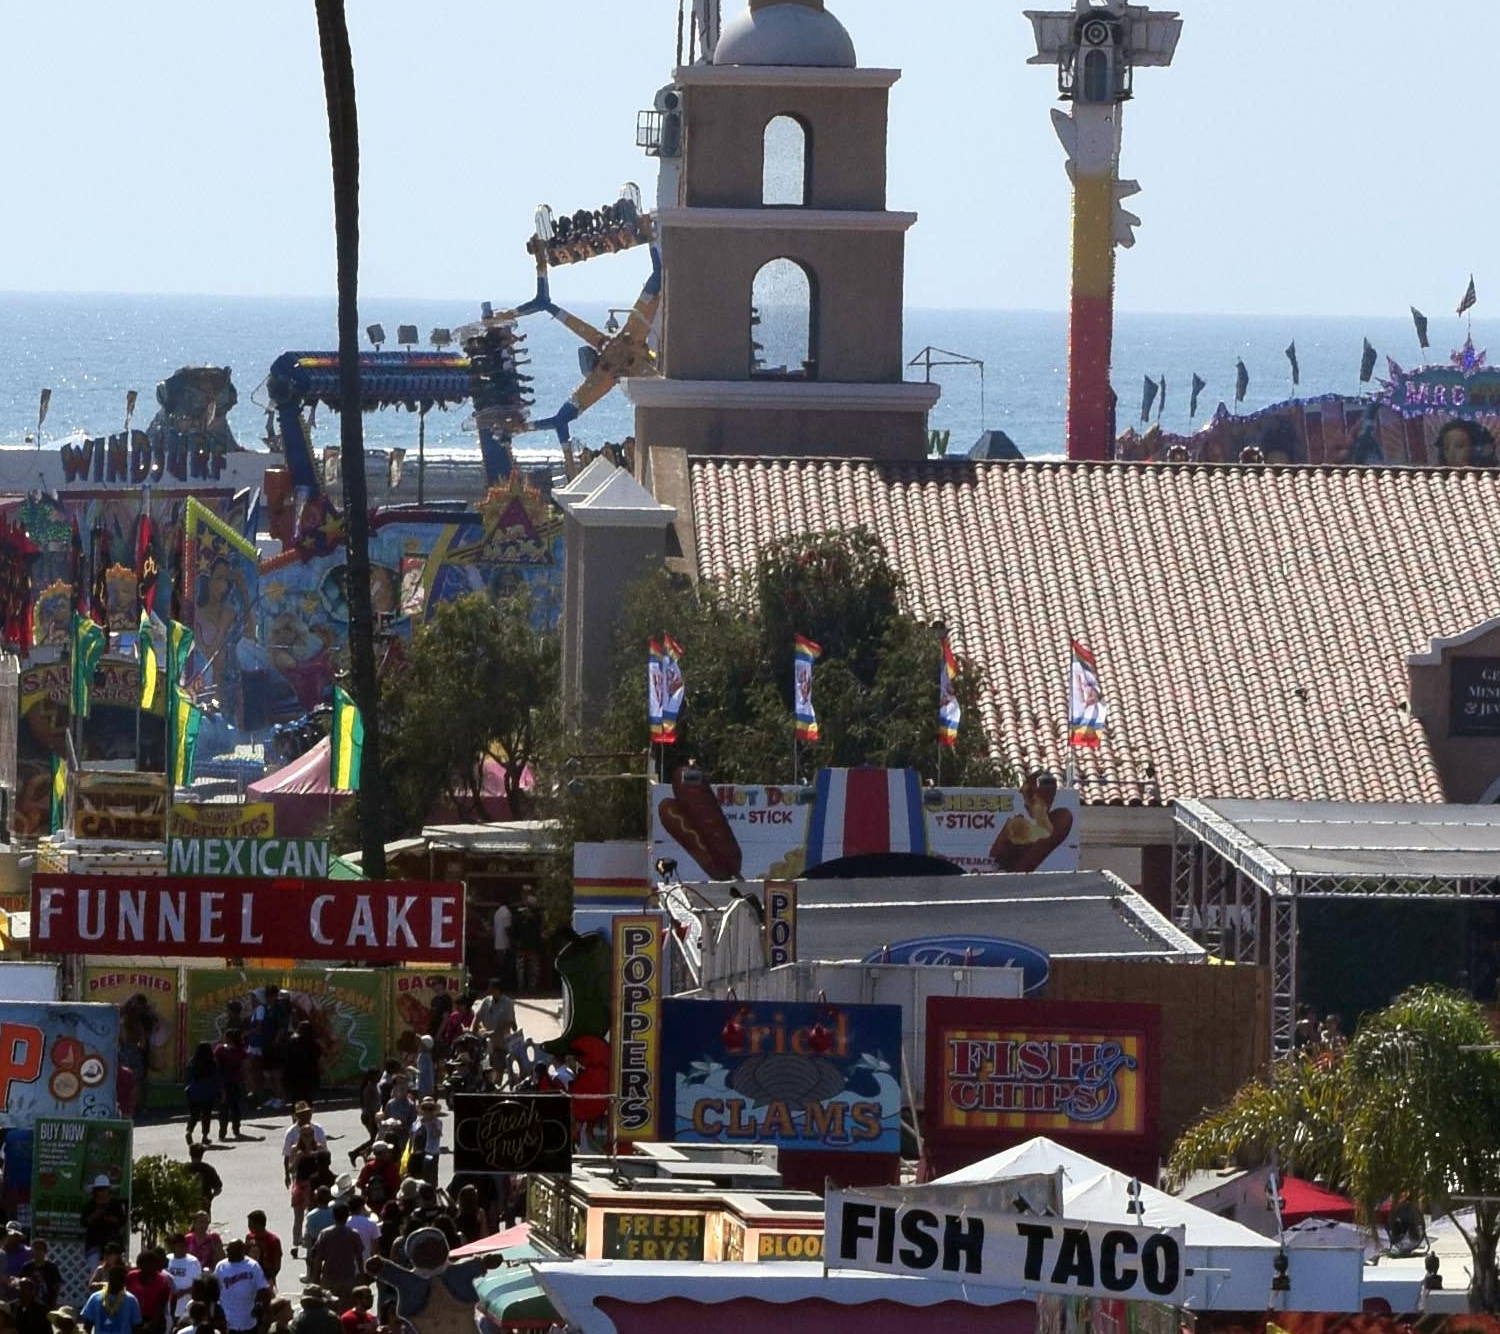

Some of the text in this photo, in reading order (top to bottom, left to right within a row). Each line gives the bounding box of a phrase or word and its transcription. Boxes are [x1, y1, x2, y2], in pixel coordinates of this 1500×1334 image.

[60, 429, 227, 483] WINDSURF
[748, 810, 793, 826] STICK
[946, 813, 996, 830] STICK
[170, 838, 329, 877] MEXICAN
[38, 888, 457, 949] FUNNEL CAKE
[90, 974, 172, 992] DEEP FRIED
[621, 926, 654, 1132] POPPERS
[948, 1039, 1100, 1081] FISH
[949, 1080, 1100, 1114] CHIPS
[41, 1122, 85, 1141] BUY NOW
[481, 1103, 542, 1140] Fresh
[693, 1099, 882, 1144] CLAMS
[619, 1215, 699, 1239] FRESH
[627, 1239, 688, 1261] FRYS
[840, 1202, 1180, 1296] FISH TACO
